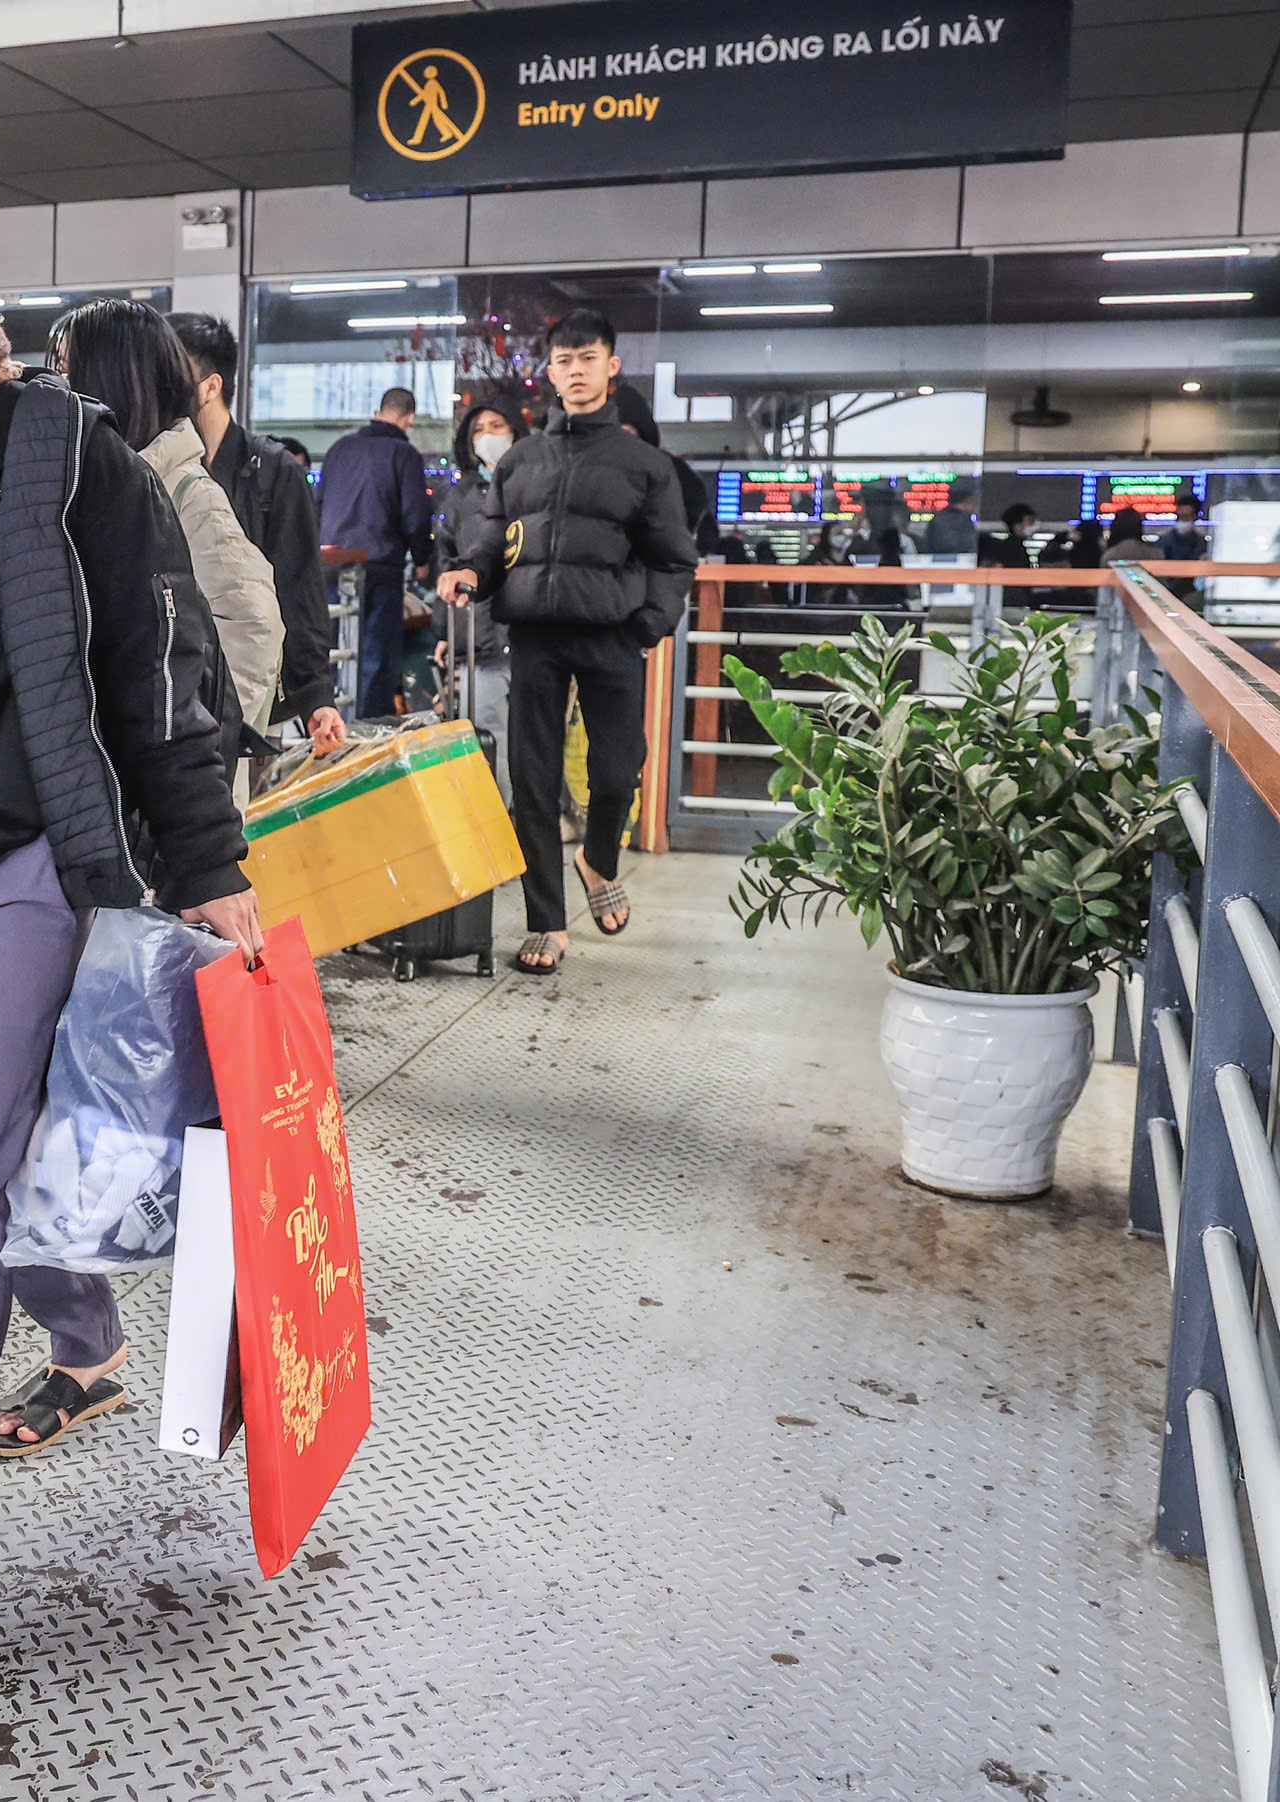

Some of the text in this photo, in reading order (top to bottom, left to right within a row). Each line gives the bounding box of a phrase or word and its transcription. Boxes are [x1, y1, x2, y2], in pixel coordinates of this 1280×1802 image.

[519, 15, 1005, 86] HÀNH KHÁCH KHÔNG RA LỐI NÀY
[518, 93, 661, 129] Entry Only
